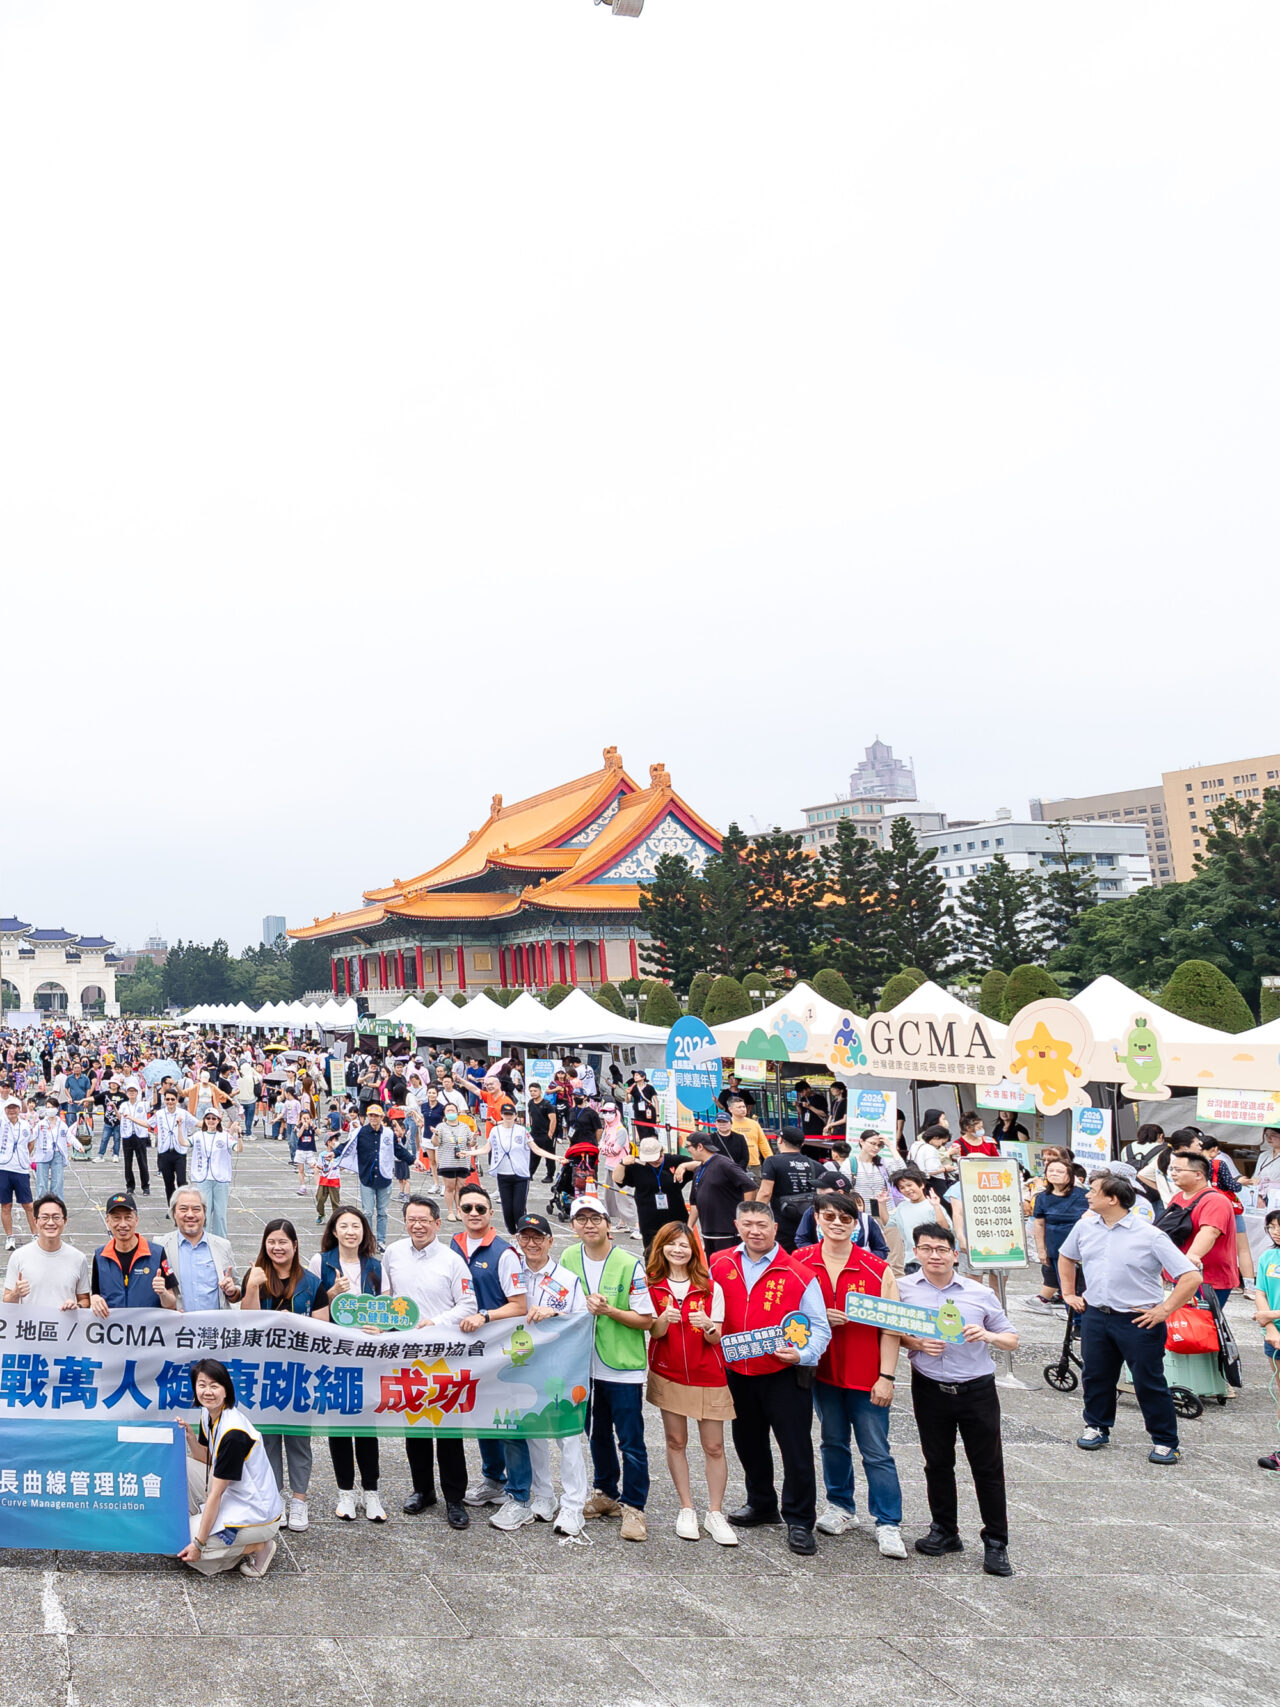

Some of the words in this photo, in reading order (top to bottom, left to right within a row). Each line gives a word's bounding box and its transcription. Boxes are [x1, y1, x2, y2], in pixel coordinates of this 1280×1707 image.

[870, 1020, 997, 1059] GCMA
[862, 1093, 883, 1103] 2026
[980, 1173, 1000, 1187] A區
[972, 1194, 1011, 1203] 0001-0064
[973, 1206, 1012, 1215] 0321-0384
[974, 1218, 1013, 1226] 0641-0704
[976, 1229, 1015, 1238] 0961-1024
[15, 1320, 59, 1342] 地區
[86, 1322, 166, 1347] GCMA
[175, 1326, 488, 1360] 台灣健康促進成長曲線管理協會
[373, 1367, 481, 1415] 成功
[1, 1498, 27, 1508] Curve
[30, 1499, 90, 1510] Management
[93, 1501, 145, 1511] Association
